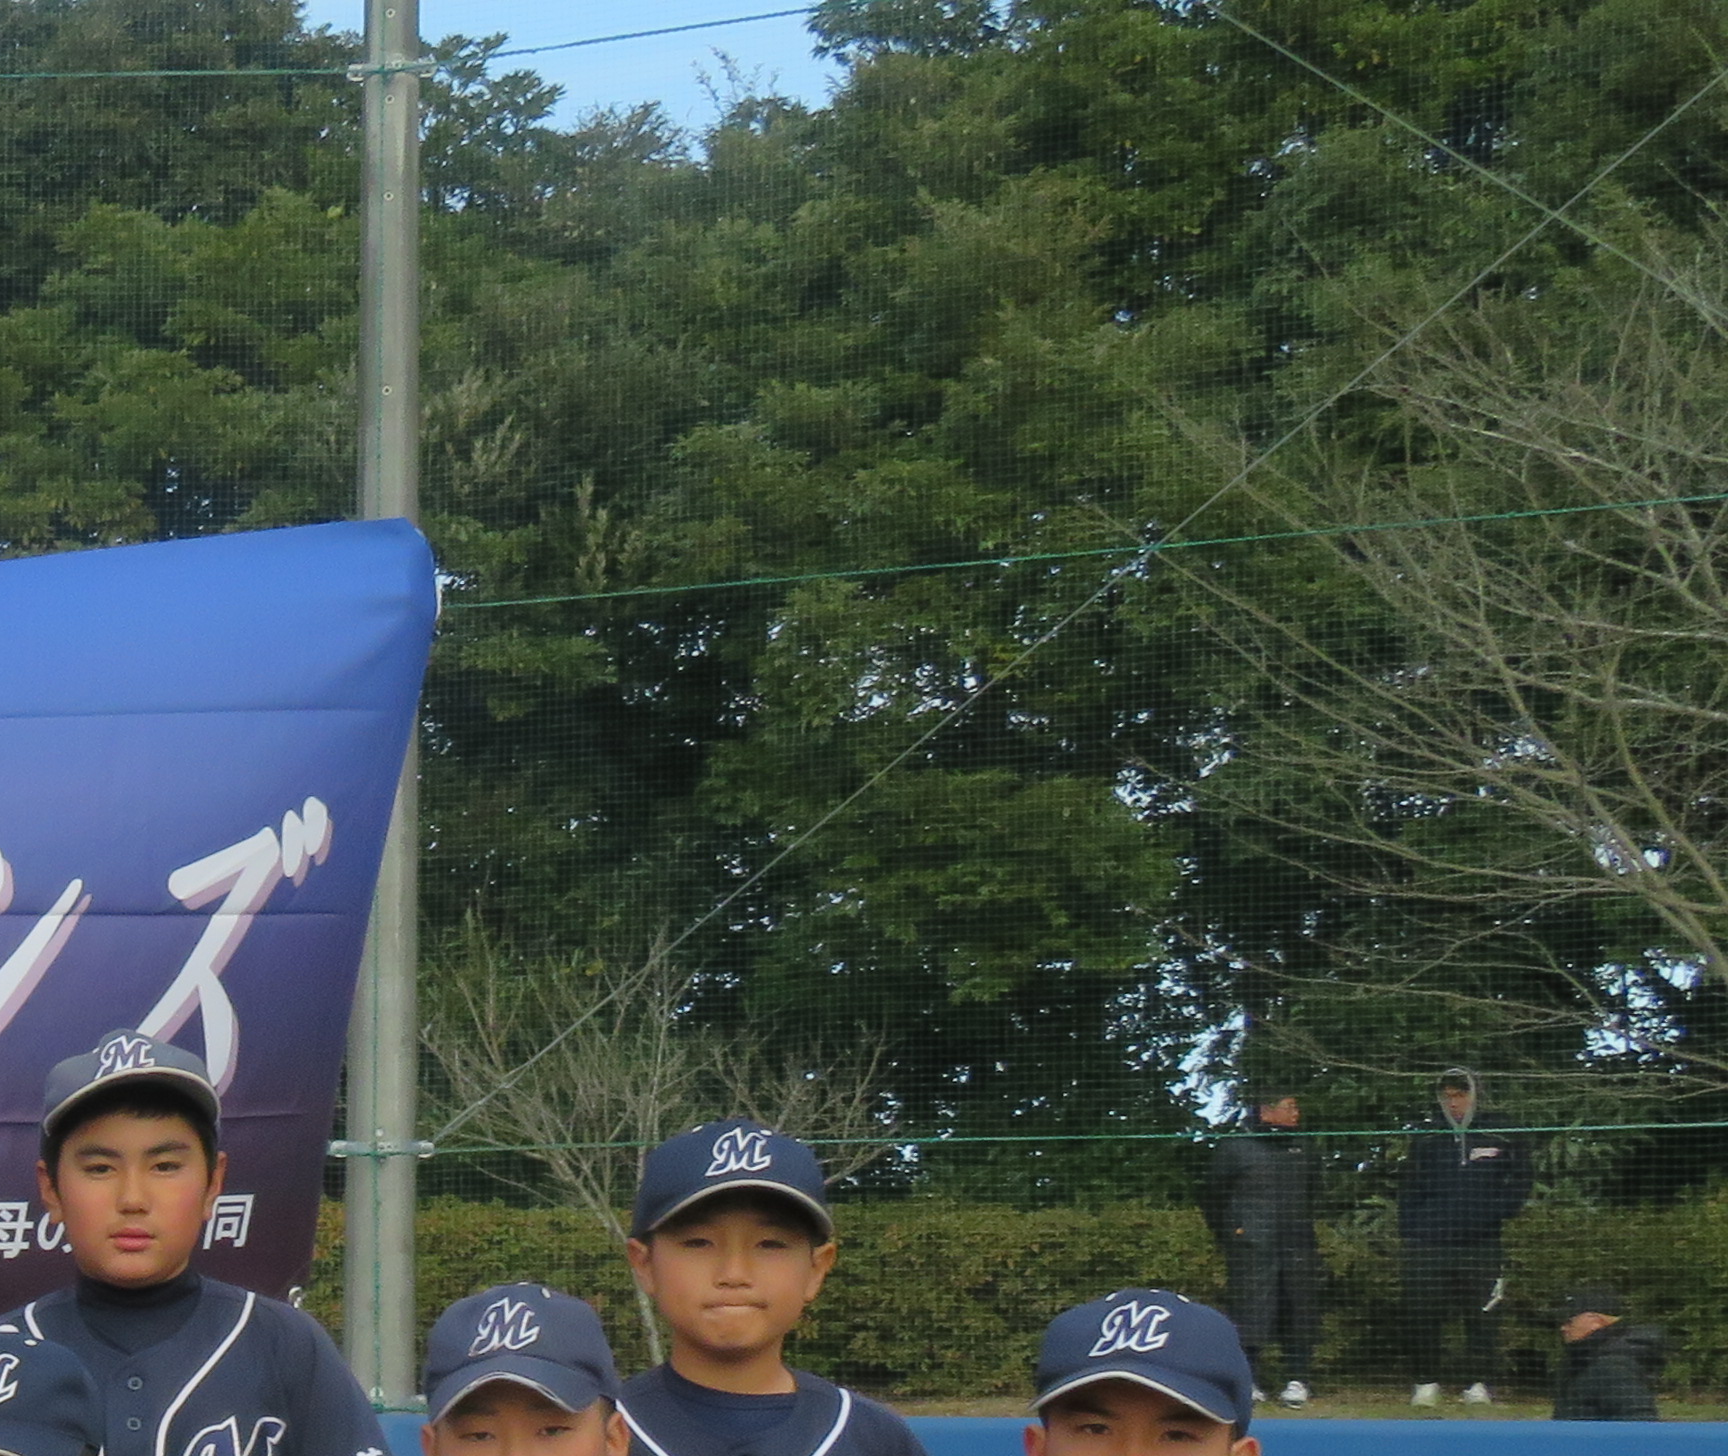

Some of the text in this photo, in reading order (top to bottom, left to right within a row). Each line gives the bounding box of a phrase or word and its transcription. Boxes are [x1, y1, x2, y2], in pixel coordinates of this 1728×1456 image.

[95, 1034, 156, 1079] M
[705, 1127, 772, 1177] M
[467, 1297, 540, 1357] M
[1088, 1301, 1172, 1357] M
